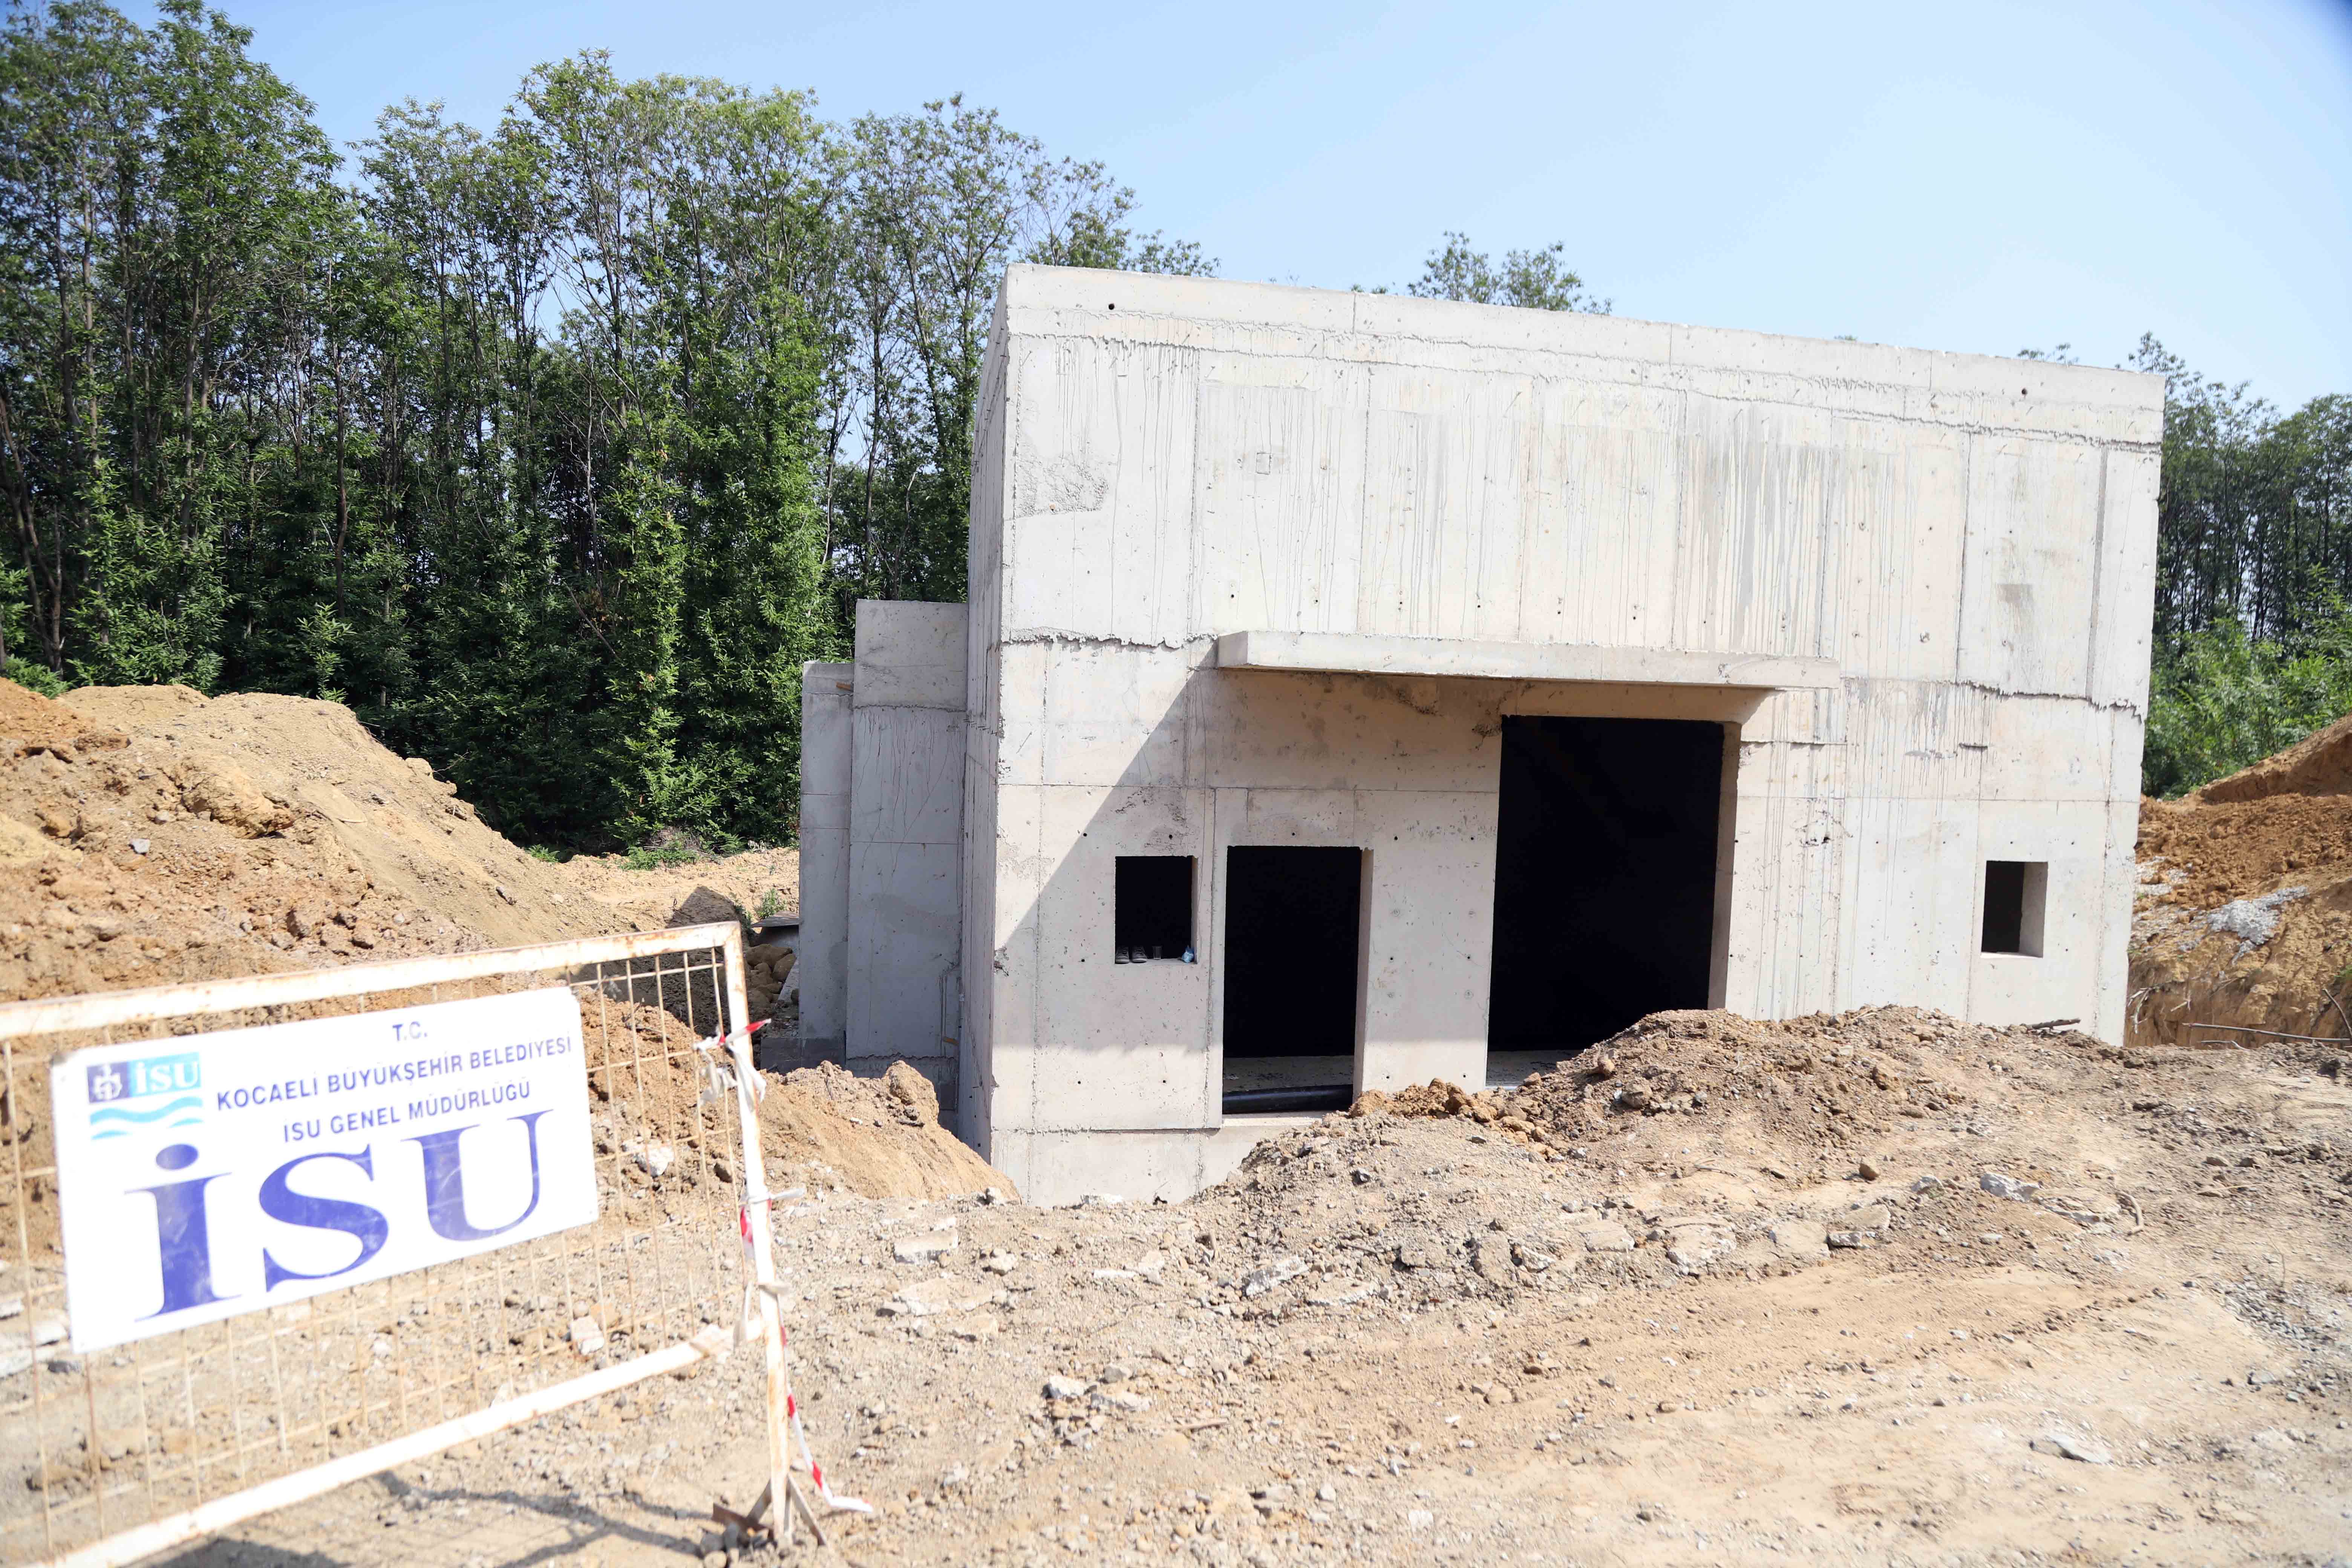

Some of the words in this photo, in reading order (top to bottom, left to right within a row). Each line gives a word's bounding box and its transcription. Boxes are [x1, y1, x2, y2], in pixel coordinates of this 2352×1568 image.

[392, 1020, 428, 1041] T.C.
[135, 1061, 199, 1094] İSU
[217, 1070, 318, 1111] KOCAELİ
[327, 1051, 463, 1093] BÜYÜKŞEHİR
[470, 1031, 571, 1069] BELEDİYESİ
[330, 1106, 401, 1134] GENEL
[408, 1077, 531, 1120] MÜDÜRLÜĞÜ
[124, 1109, 554, 1322] İSU
